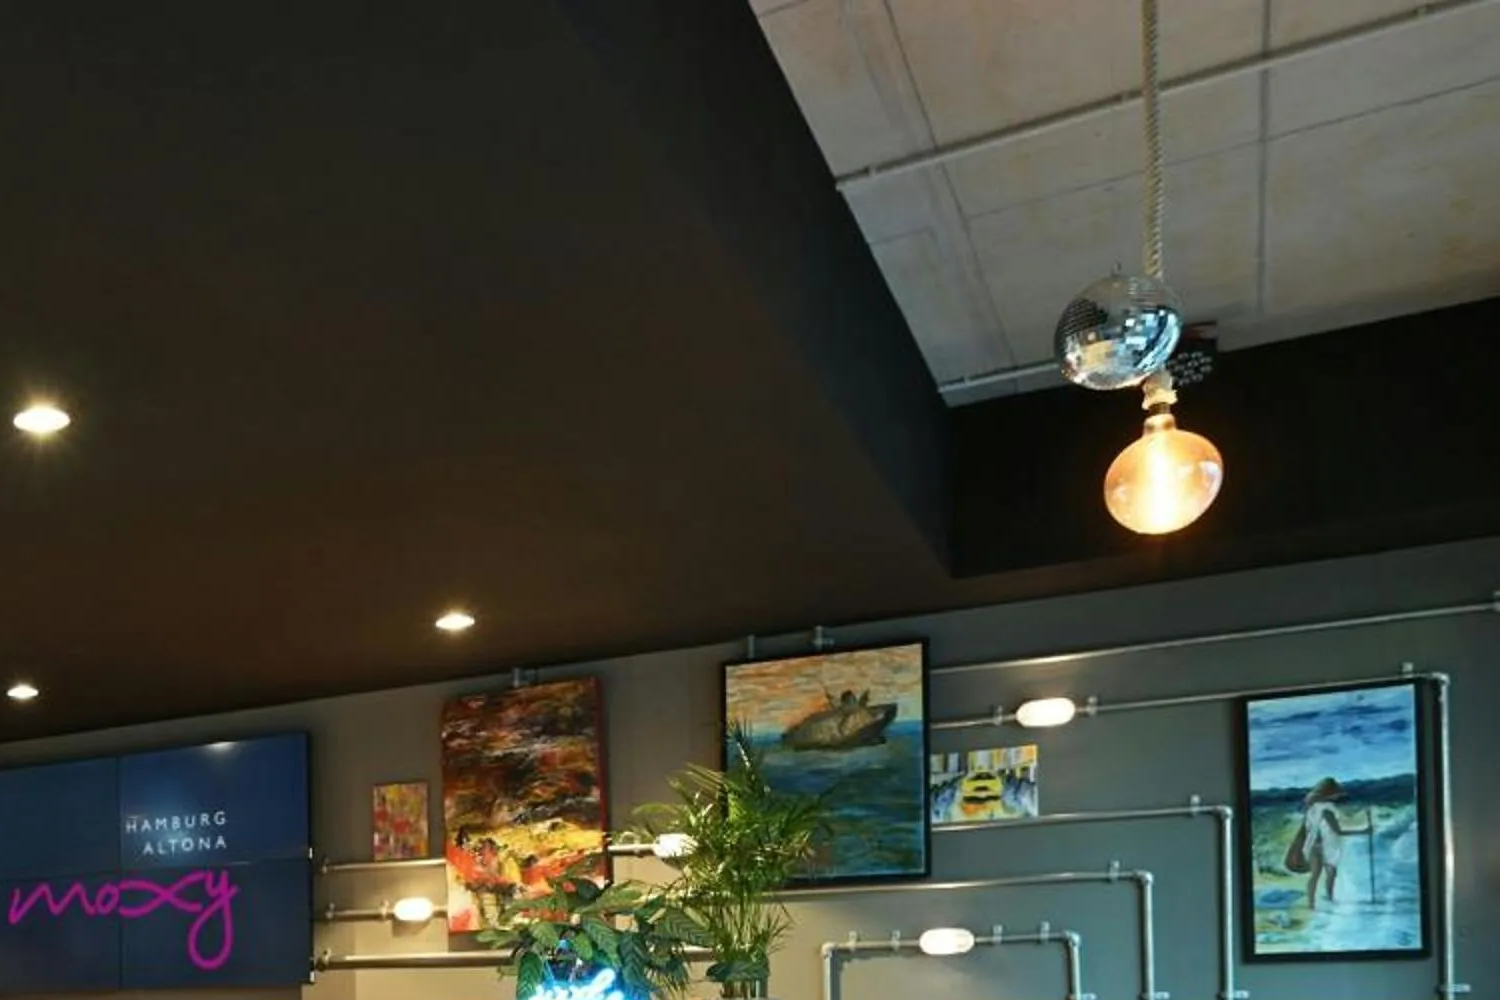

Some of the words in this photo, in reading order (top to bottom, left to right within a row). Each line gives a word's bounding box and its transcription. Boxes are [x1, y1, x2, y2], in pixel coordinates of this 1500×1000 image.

[125, 810, 226, 833] HAMBURG
[142, 835, 227, 856] ALTONA
[8, 869, 239, 970] moxy
